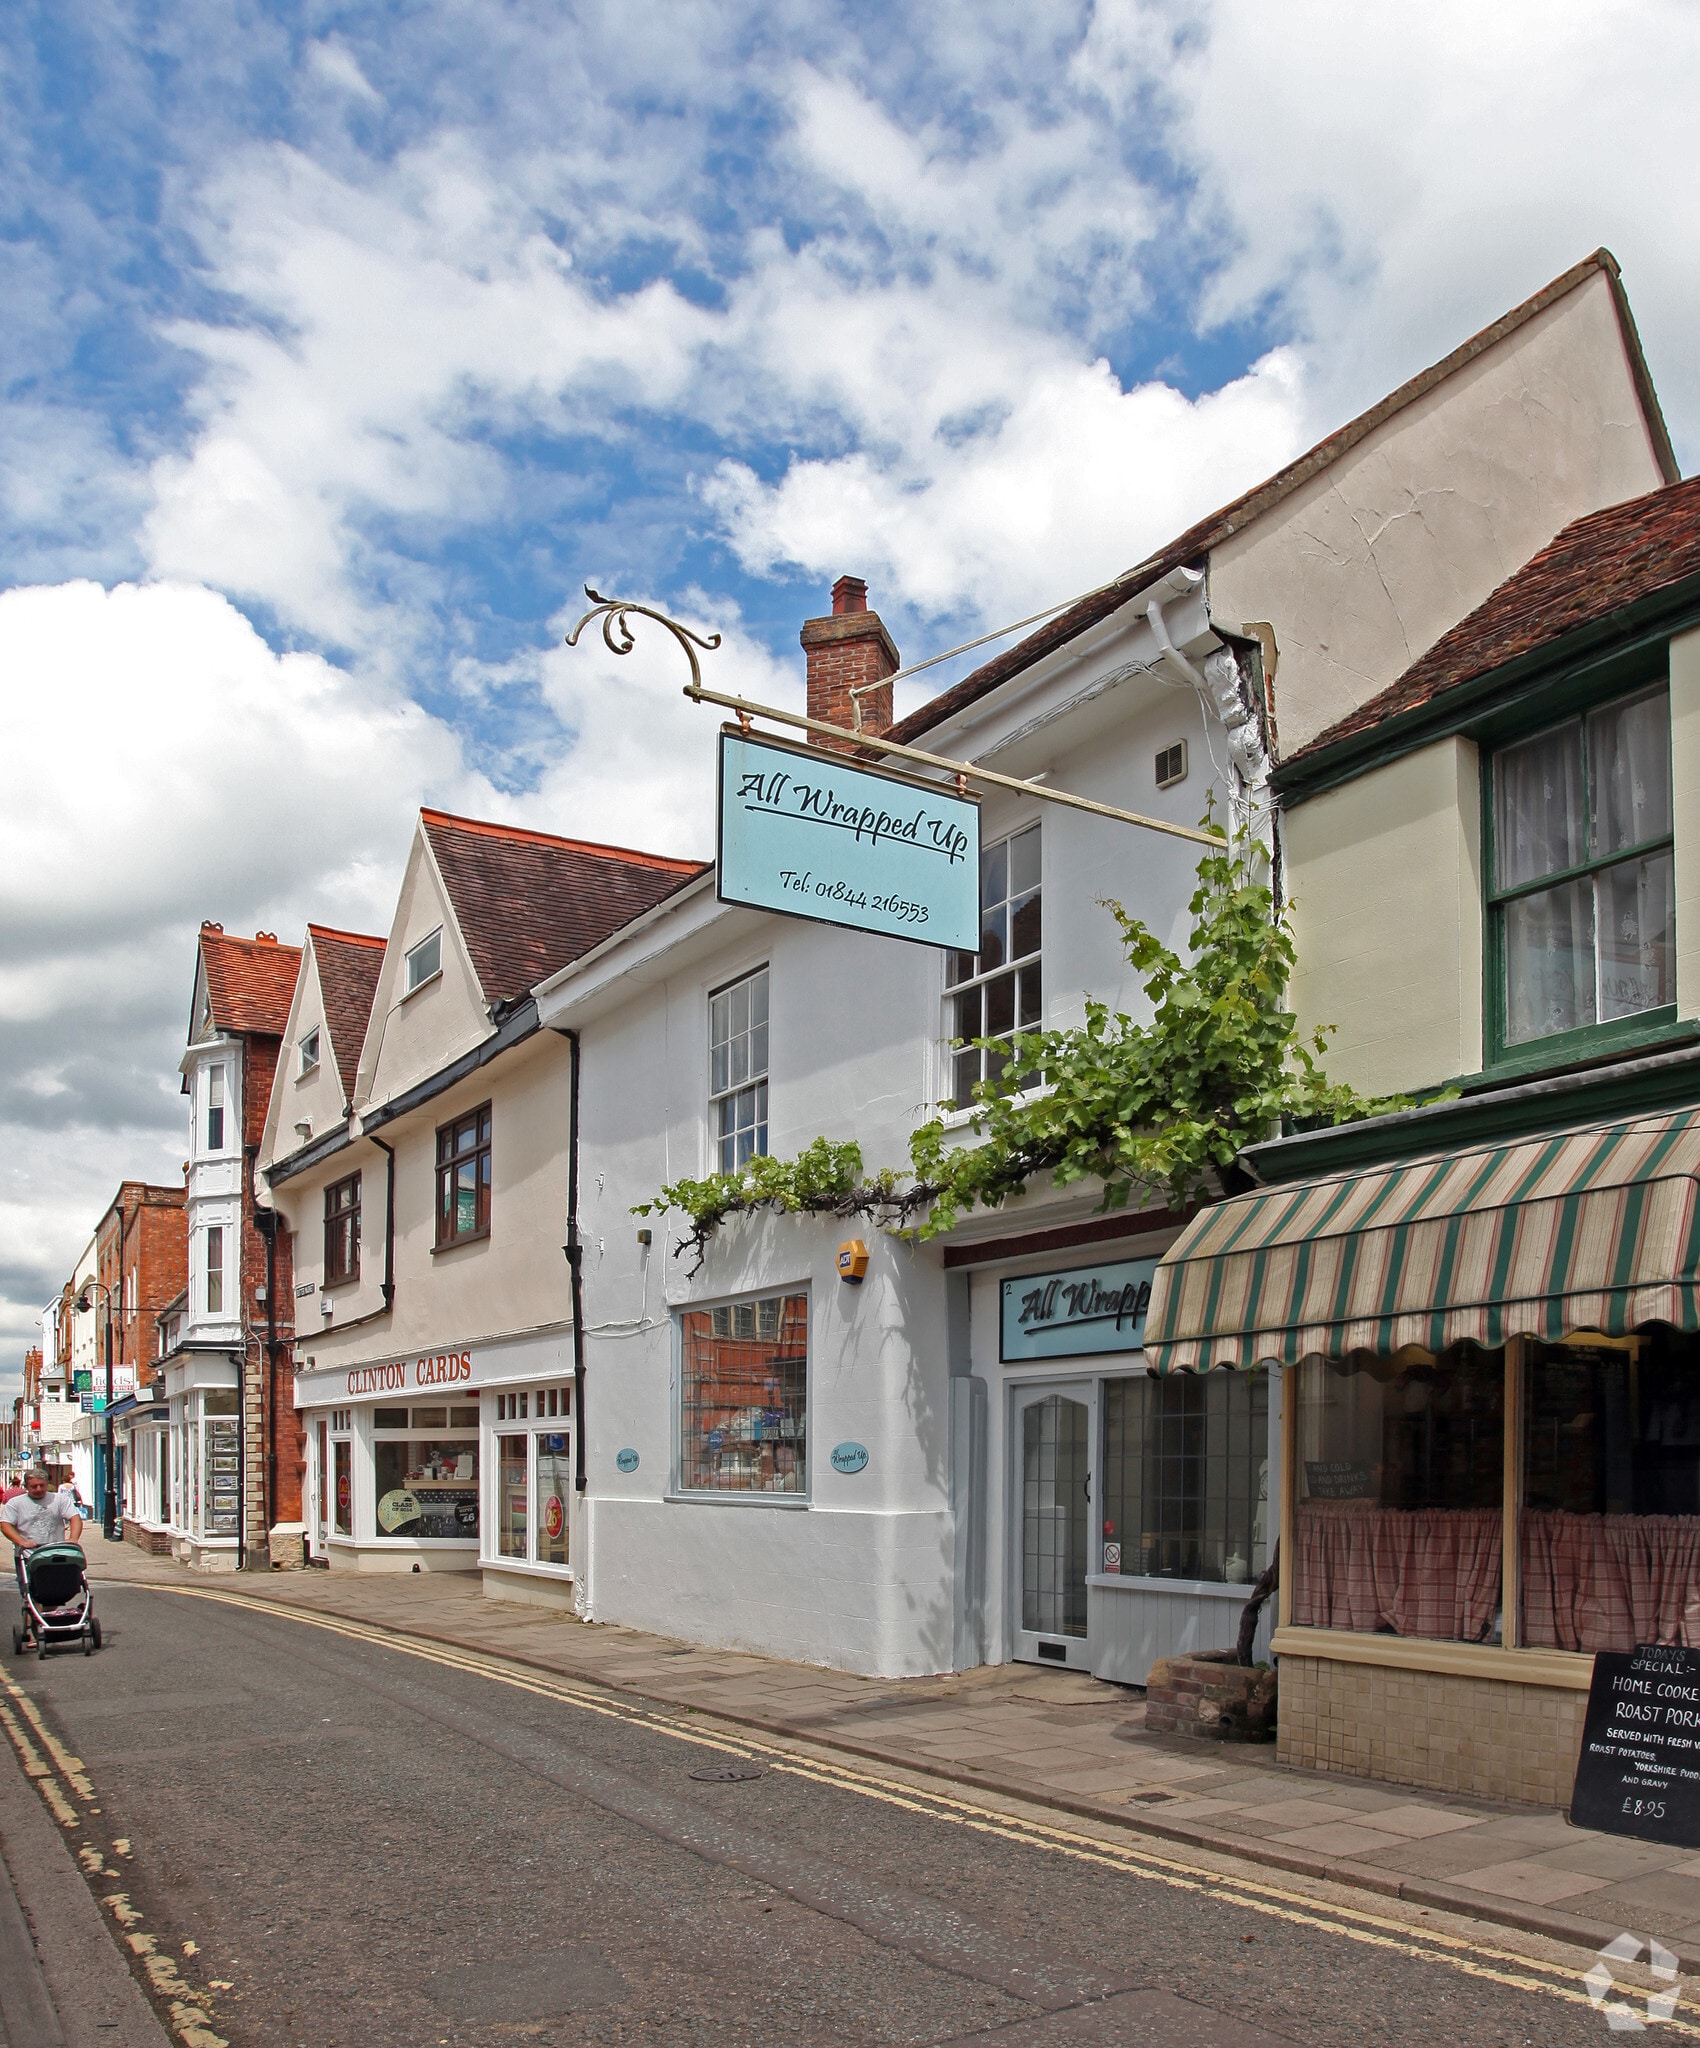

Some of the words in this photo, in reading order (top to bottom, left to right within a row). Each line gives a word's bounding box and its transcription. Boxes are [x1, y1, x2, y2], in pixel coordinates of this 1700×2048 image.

[737, 772, 792, 805] All
[793, 785, 927, 846] Wrapped
[927, 820, 968, 865] Up
[780, 871, 813, 894] Tel:
[815, 882, 867, 909] 01844
[871, 894, 929, 924] 216553
[1005, 1283, 1013, 1296] 2
[1018, 1279, 1062, 1323] All
[1062, 1278, 1152, 1332] Wrapp
[348, 1362, 407, 1395] CLINTON
[416, 1350, 471, 1386] CARDS
[1330, 1462, 1351, 1472] COLD
[1640, 1646, 1686, 1662] TODAY'S
[1612, 1676, 1652, 1695] HOME
[1656, 1683, 1700, 1702] COOKE
[1615, 1702, 1663, 1722] ROAST
[1606, 1727, 1641, 1741] SERVED
[1643, 1733, 1665, 1745] WITH
[1667, 1736, 1692, 1749] FRESH
[1589, 1743, 1616, 1755] ROAST
[1634, 1761, 1677, 1776] YORKSHIRE
[1679, 1768, 1700, 1780] PUDD
[1621, 1775, 1639, 1784] AND
[1641, 1778, 1669, 1790] GRAVY
